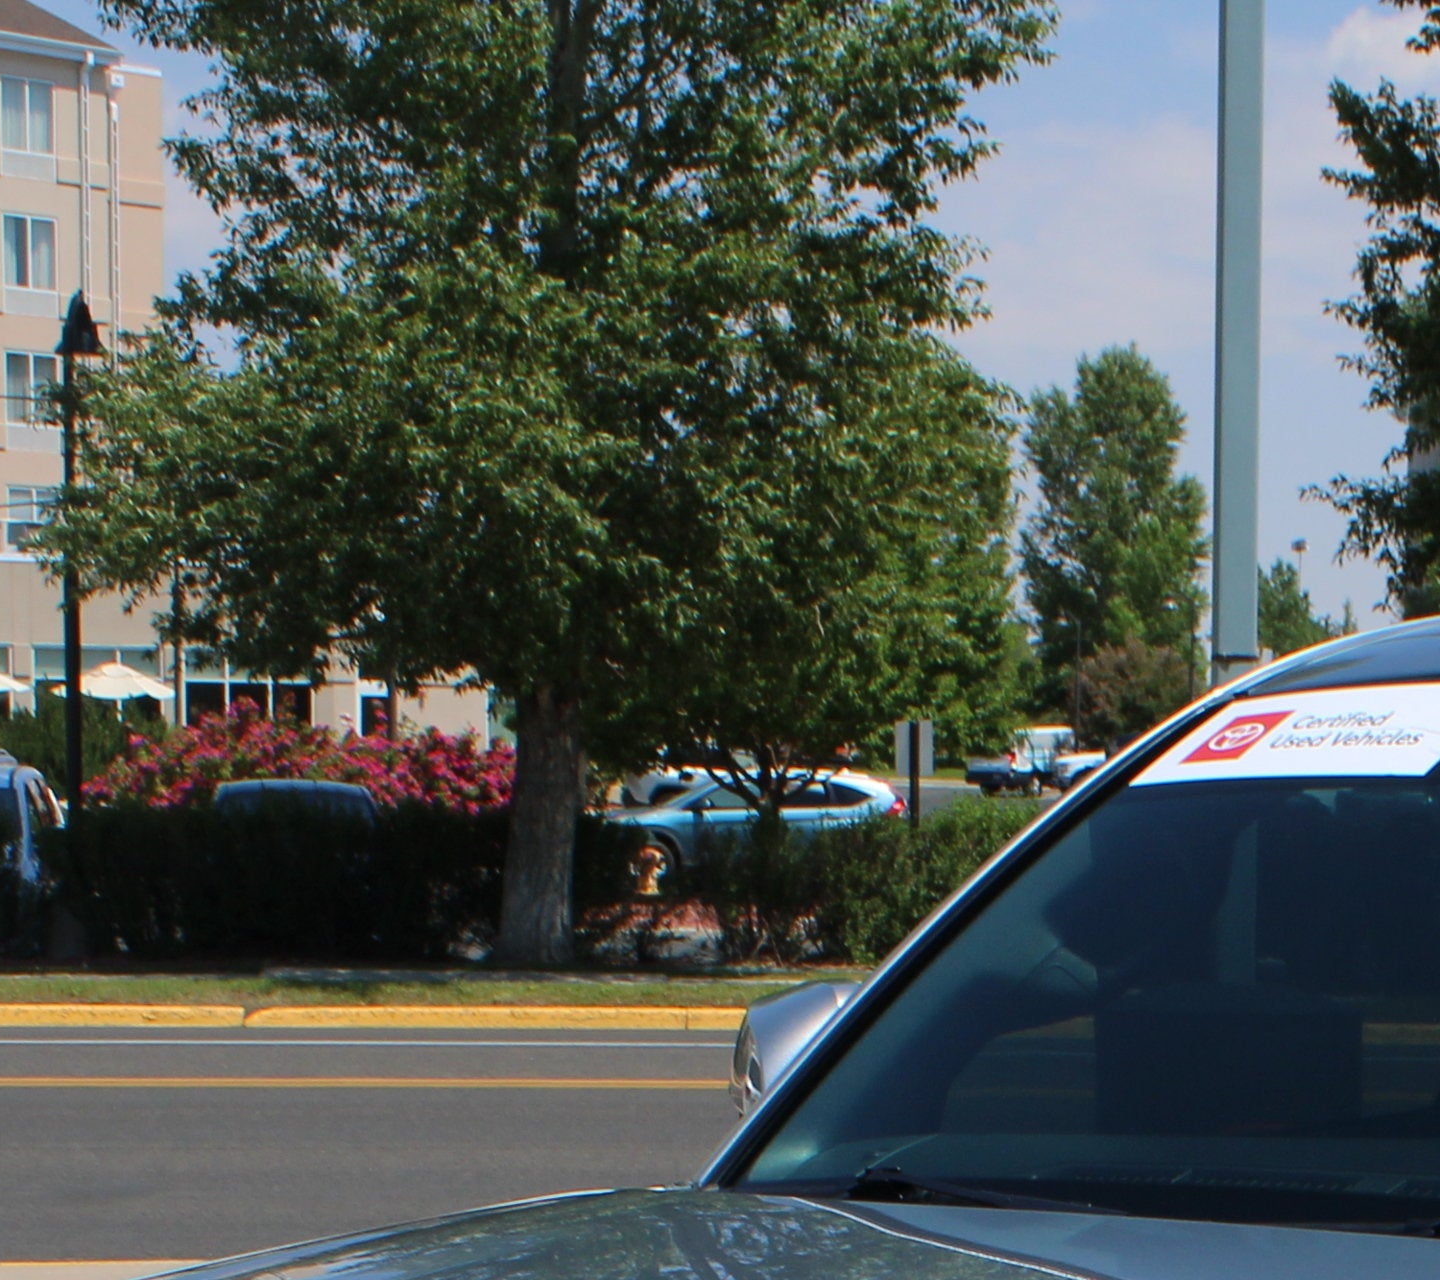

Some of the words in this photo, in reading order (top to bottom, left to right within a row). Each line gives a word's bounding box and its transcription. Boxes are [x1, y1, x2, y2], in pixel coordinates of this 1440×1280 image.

[1292, 711, 1395, 728] Certified
[1270, 731, 1332, 749] Used
[1330, 730, 1424, 748] Vehicles
